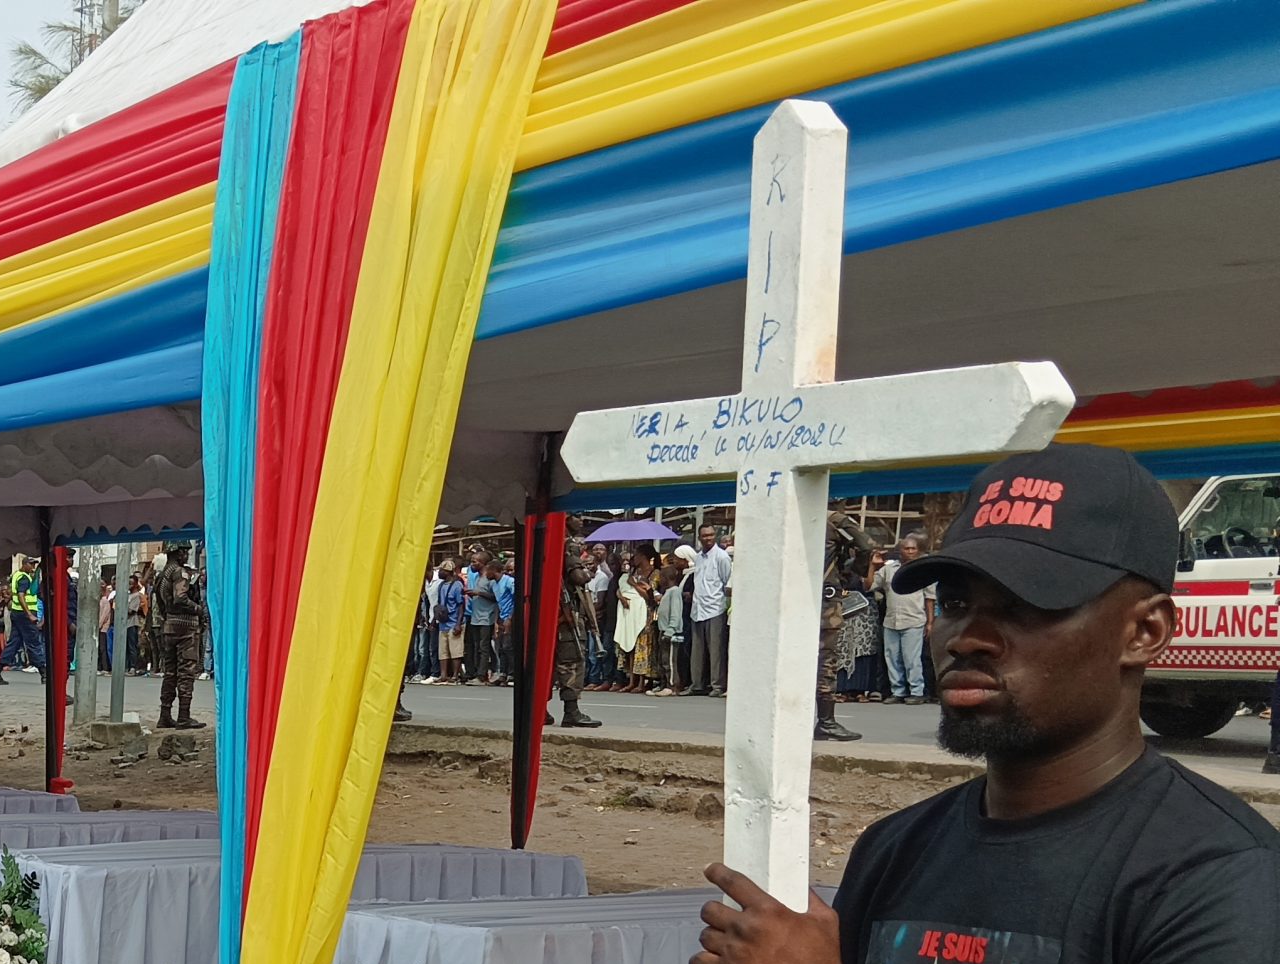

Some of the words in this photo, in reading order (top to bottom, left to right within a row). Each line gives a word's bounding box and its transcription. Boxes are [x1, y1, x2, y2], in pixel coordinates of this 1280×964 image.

[712, 396, 803, 430] BIKULO
[979, 480, 1004, 503] JE
[1009, 476, 1064, 502] SUIS
[973, 500, 1053, 530] GOMA
[1172, 604, 1279, 639] BULANCE
[918, 930, 943, 957] JE
[942, 932, 990, 964] SUIS
